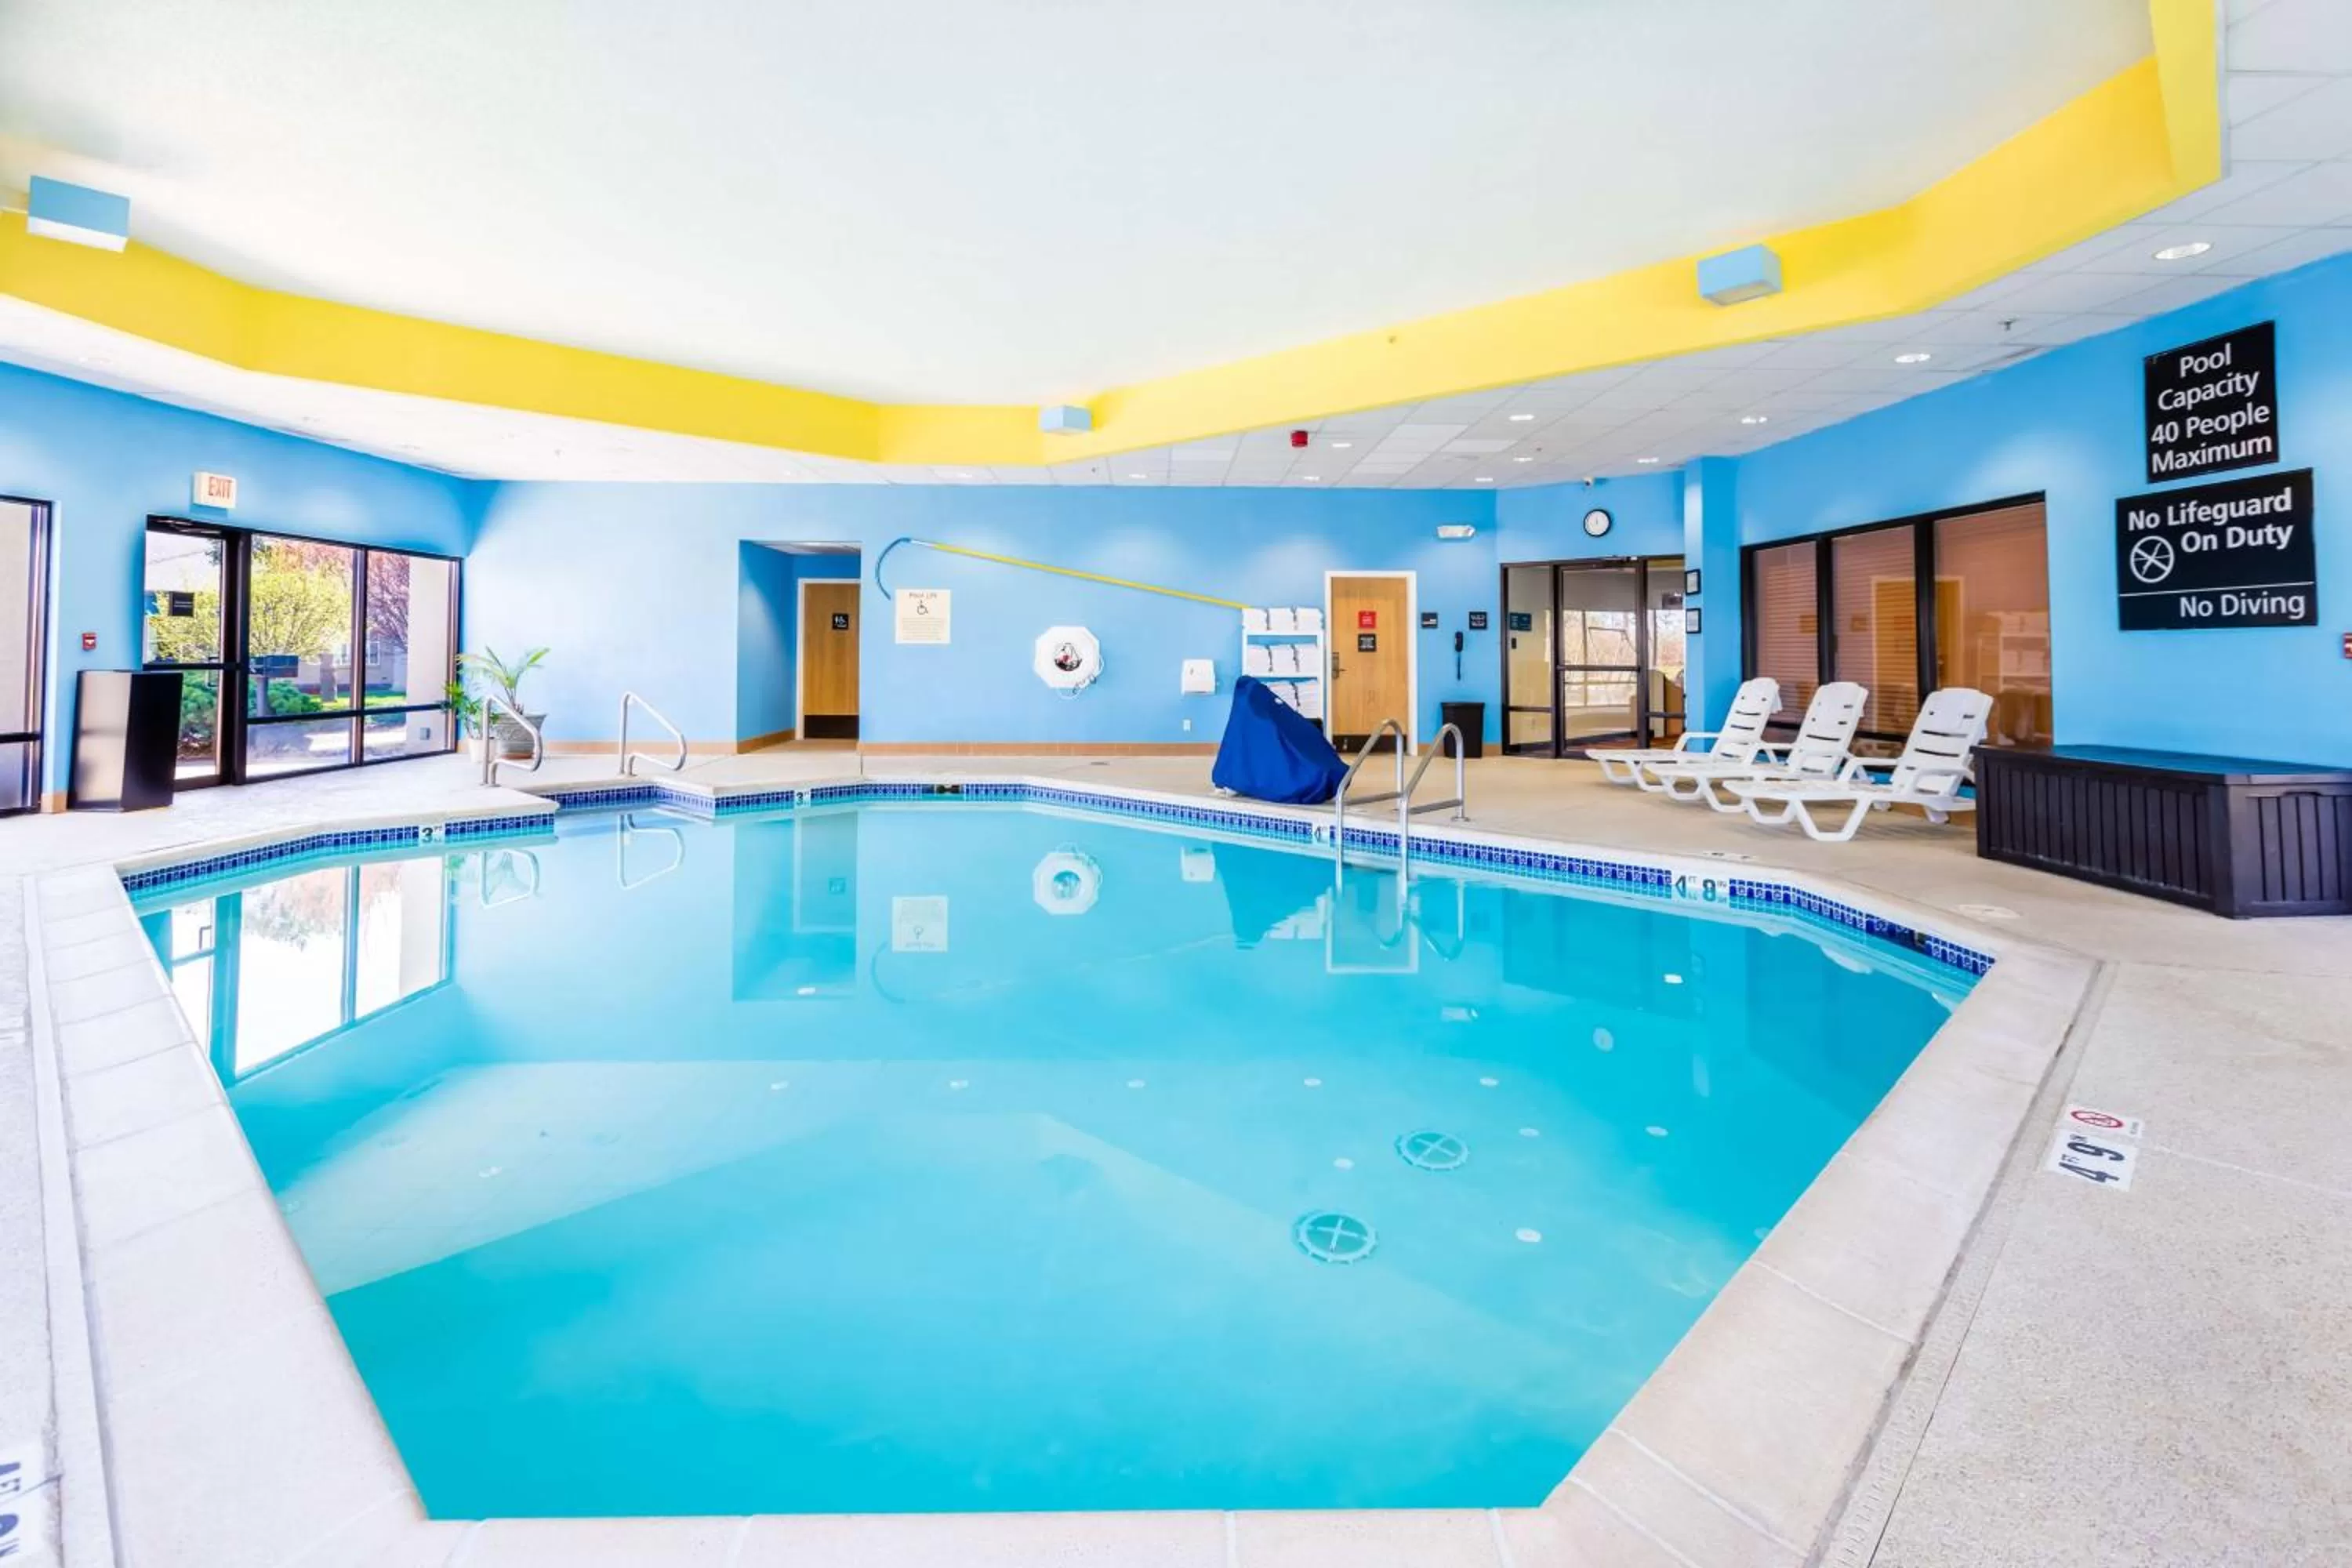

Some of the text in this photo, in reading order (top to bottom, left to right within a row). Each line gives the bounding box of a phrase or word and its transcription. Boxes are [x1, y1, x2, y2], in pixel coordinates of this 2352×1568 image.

[2180, 342, 2232, 378] Pool
[2158, 371, 2260, 411] Capacity
[2150, 401, 2270, 445] 40 People
[2151, 435, 2273, 474] Maximum
[208, 475, 233, 500] EXIT
[2127, 486, 2292, 532] No Lifeguard
[2180, 523, 2294, 553] On Duty
[2180, 590, 2306, 620] No Diving
[2066, 1142, 2125, 1161] 9
[2058, 1161, 2120, 1183] 4
